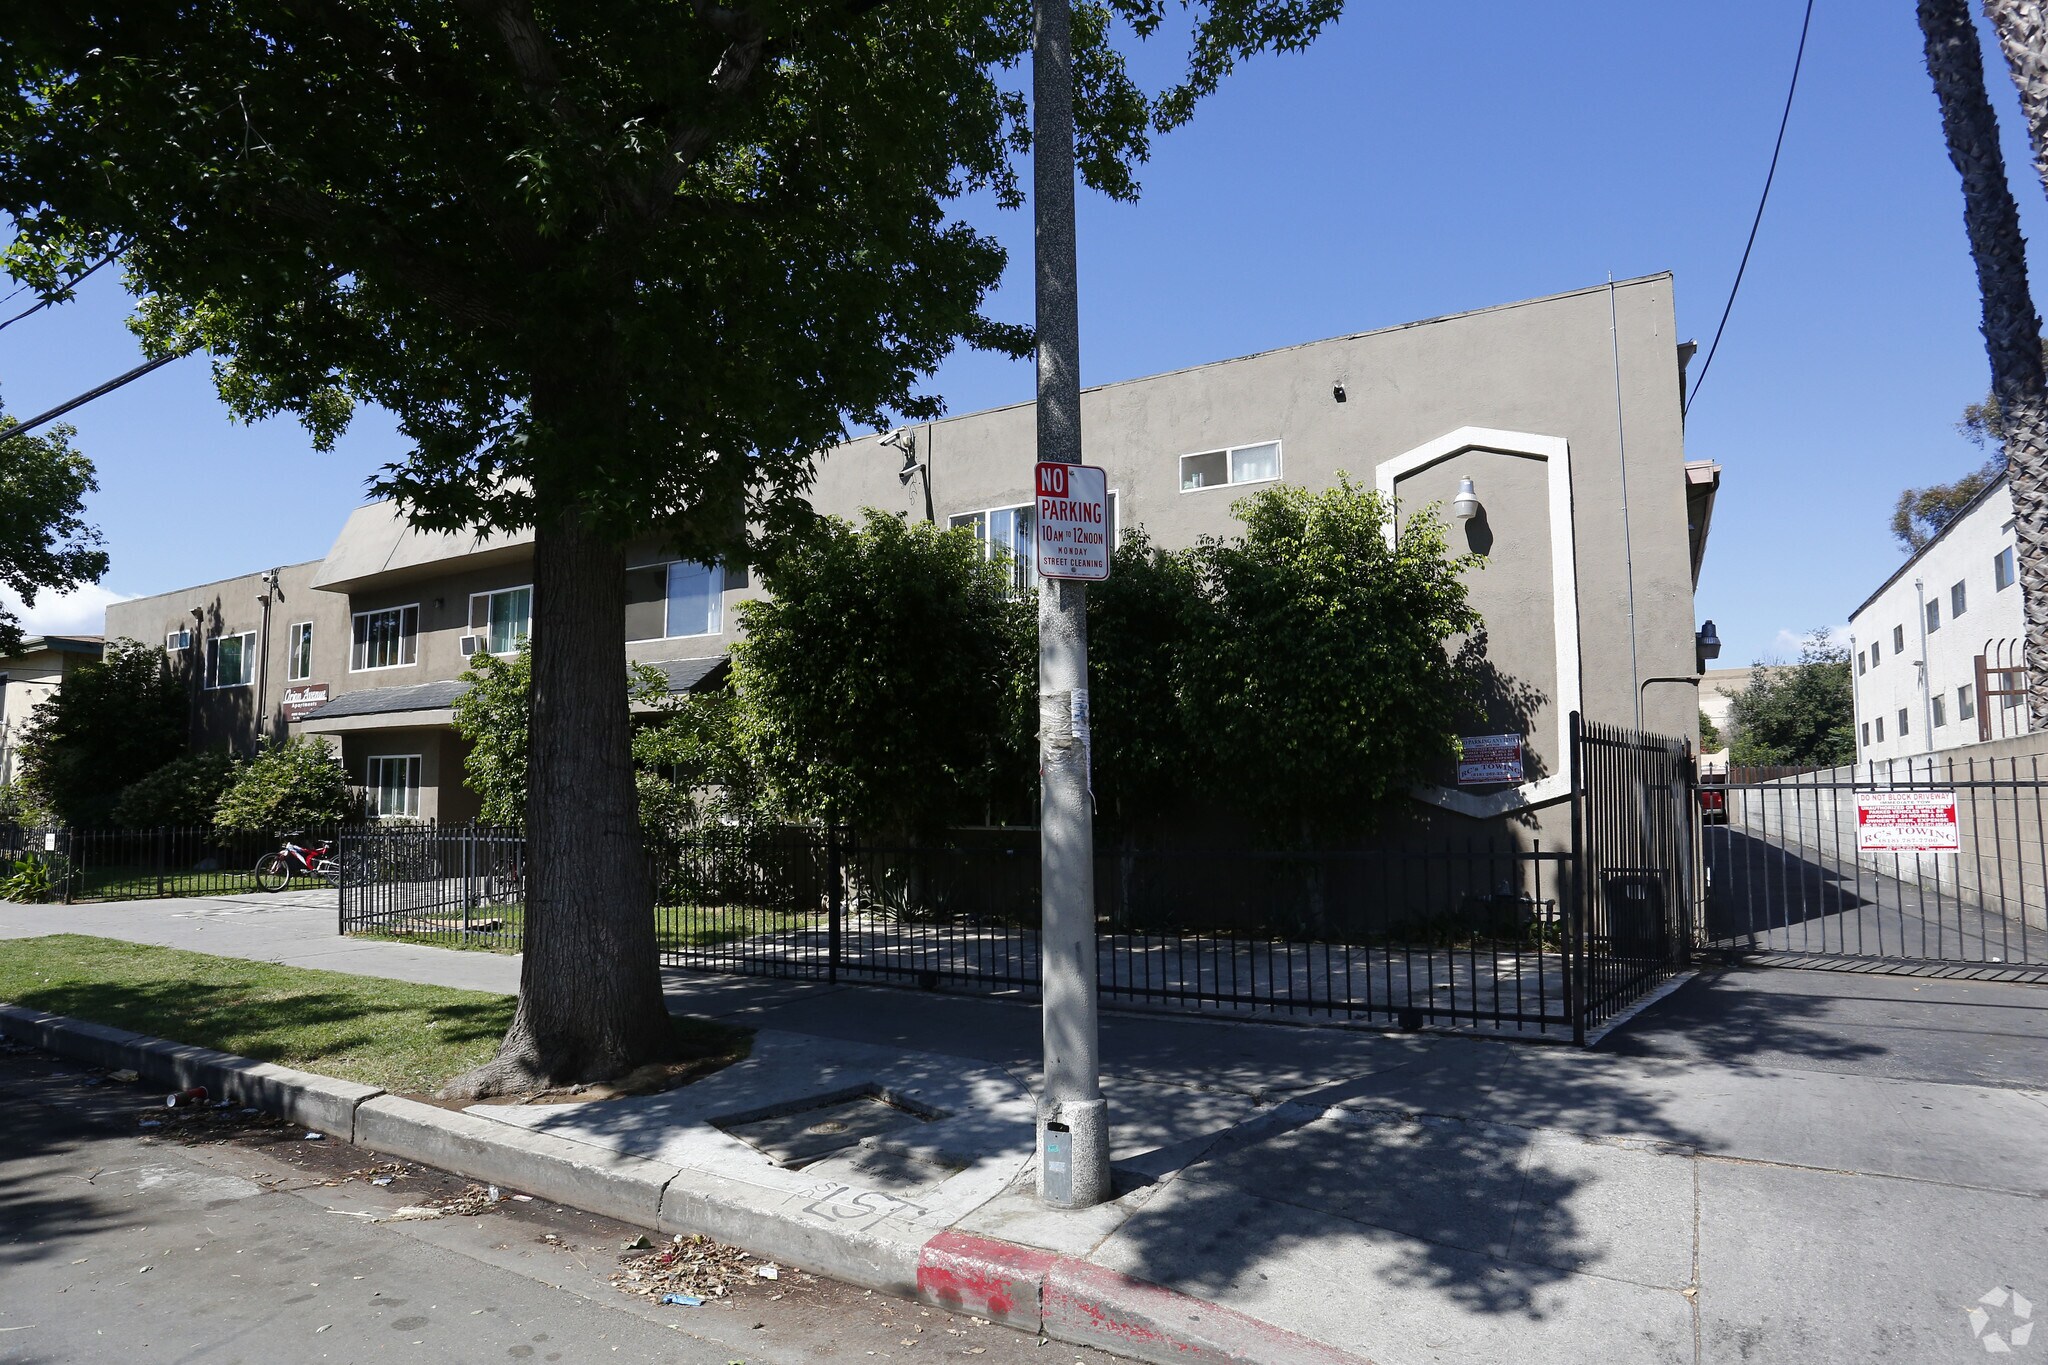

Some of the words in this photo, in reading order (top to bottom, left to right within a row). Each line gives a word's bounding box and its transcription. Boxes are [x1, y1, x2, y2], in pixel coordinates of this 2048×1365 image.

[1041, 467, 1064, 493] NO
[1042, 499, 1102, 524] PARKING
[1065, 530, 1072, 538] TO
[1058, 546, 1088, 556] MONDAY
[1043, 556, 1068, 566] STREET
[1070, 558, 1103, 568] CLEANING
[302, 687, 327, 701] Avenue
[1461, 766, 1479, 778] RC's
[1480, 763, 1520, 774] TOWING
[1888, 793, 1911, 801] BLOCK
[1864, 830, 1892, 843] RC's
[1895, 827, 1955, 842] TOWING
